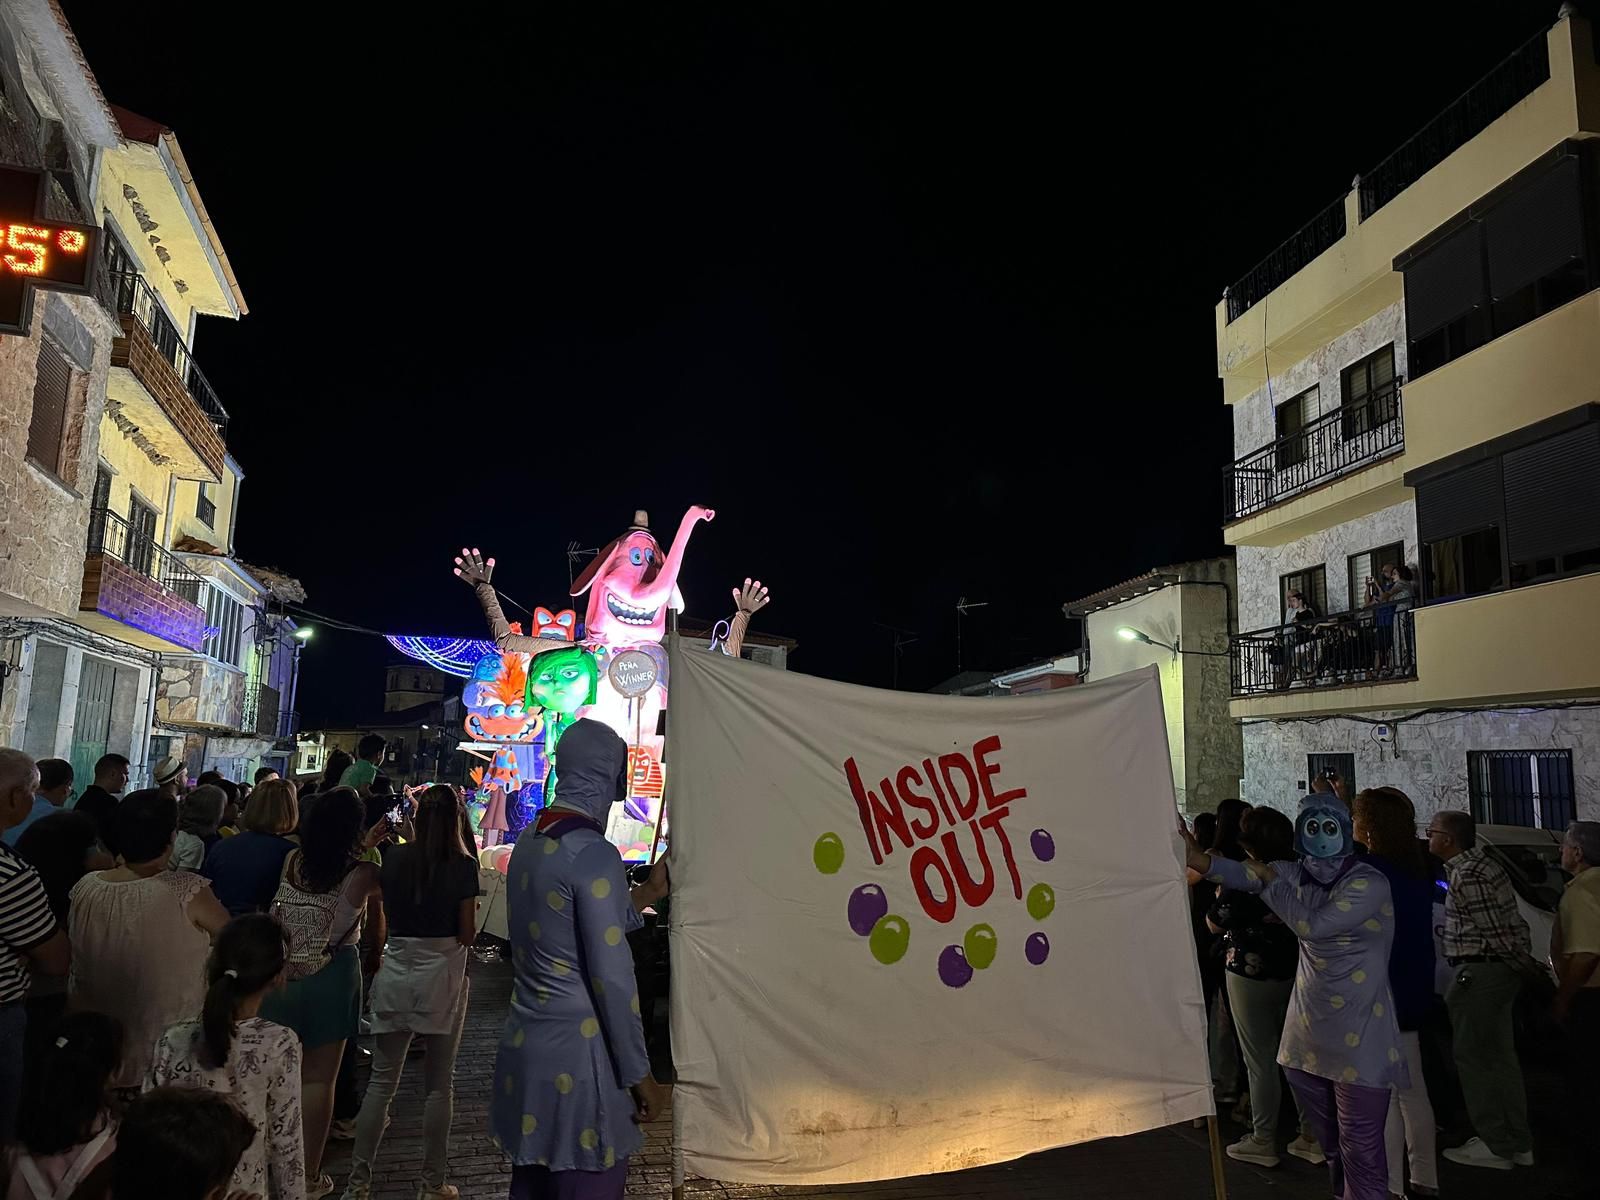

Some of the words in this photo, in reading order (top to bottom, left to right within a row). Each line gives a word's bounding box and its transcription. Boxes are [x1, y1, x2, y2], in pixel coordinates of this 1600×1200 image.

[0, 224, 85, 275] 5°
[615, 670, 655, 687] WINNER
[618, 661, 639, 672] PEÑA
[843, 735, 1027, 866] INSIDE
[909, 806, 1023, 923] OUT
